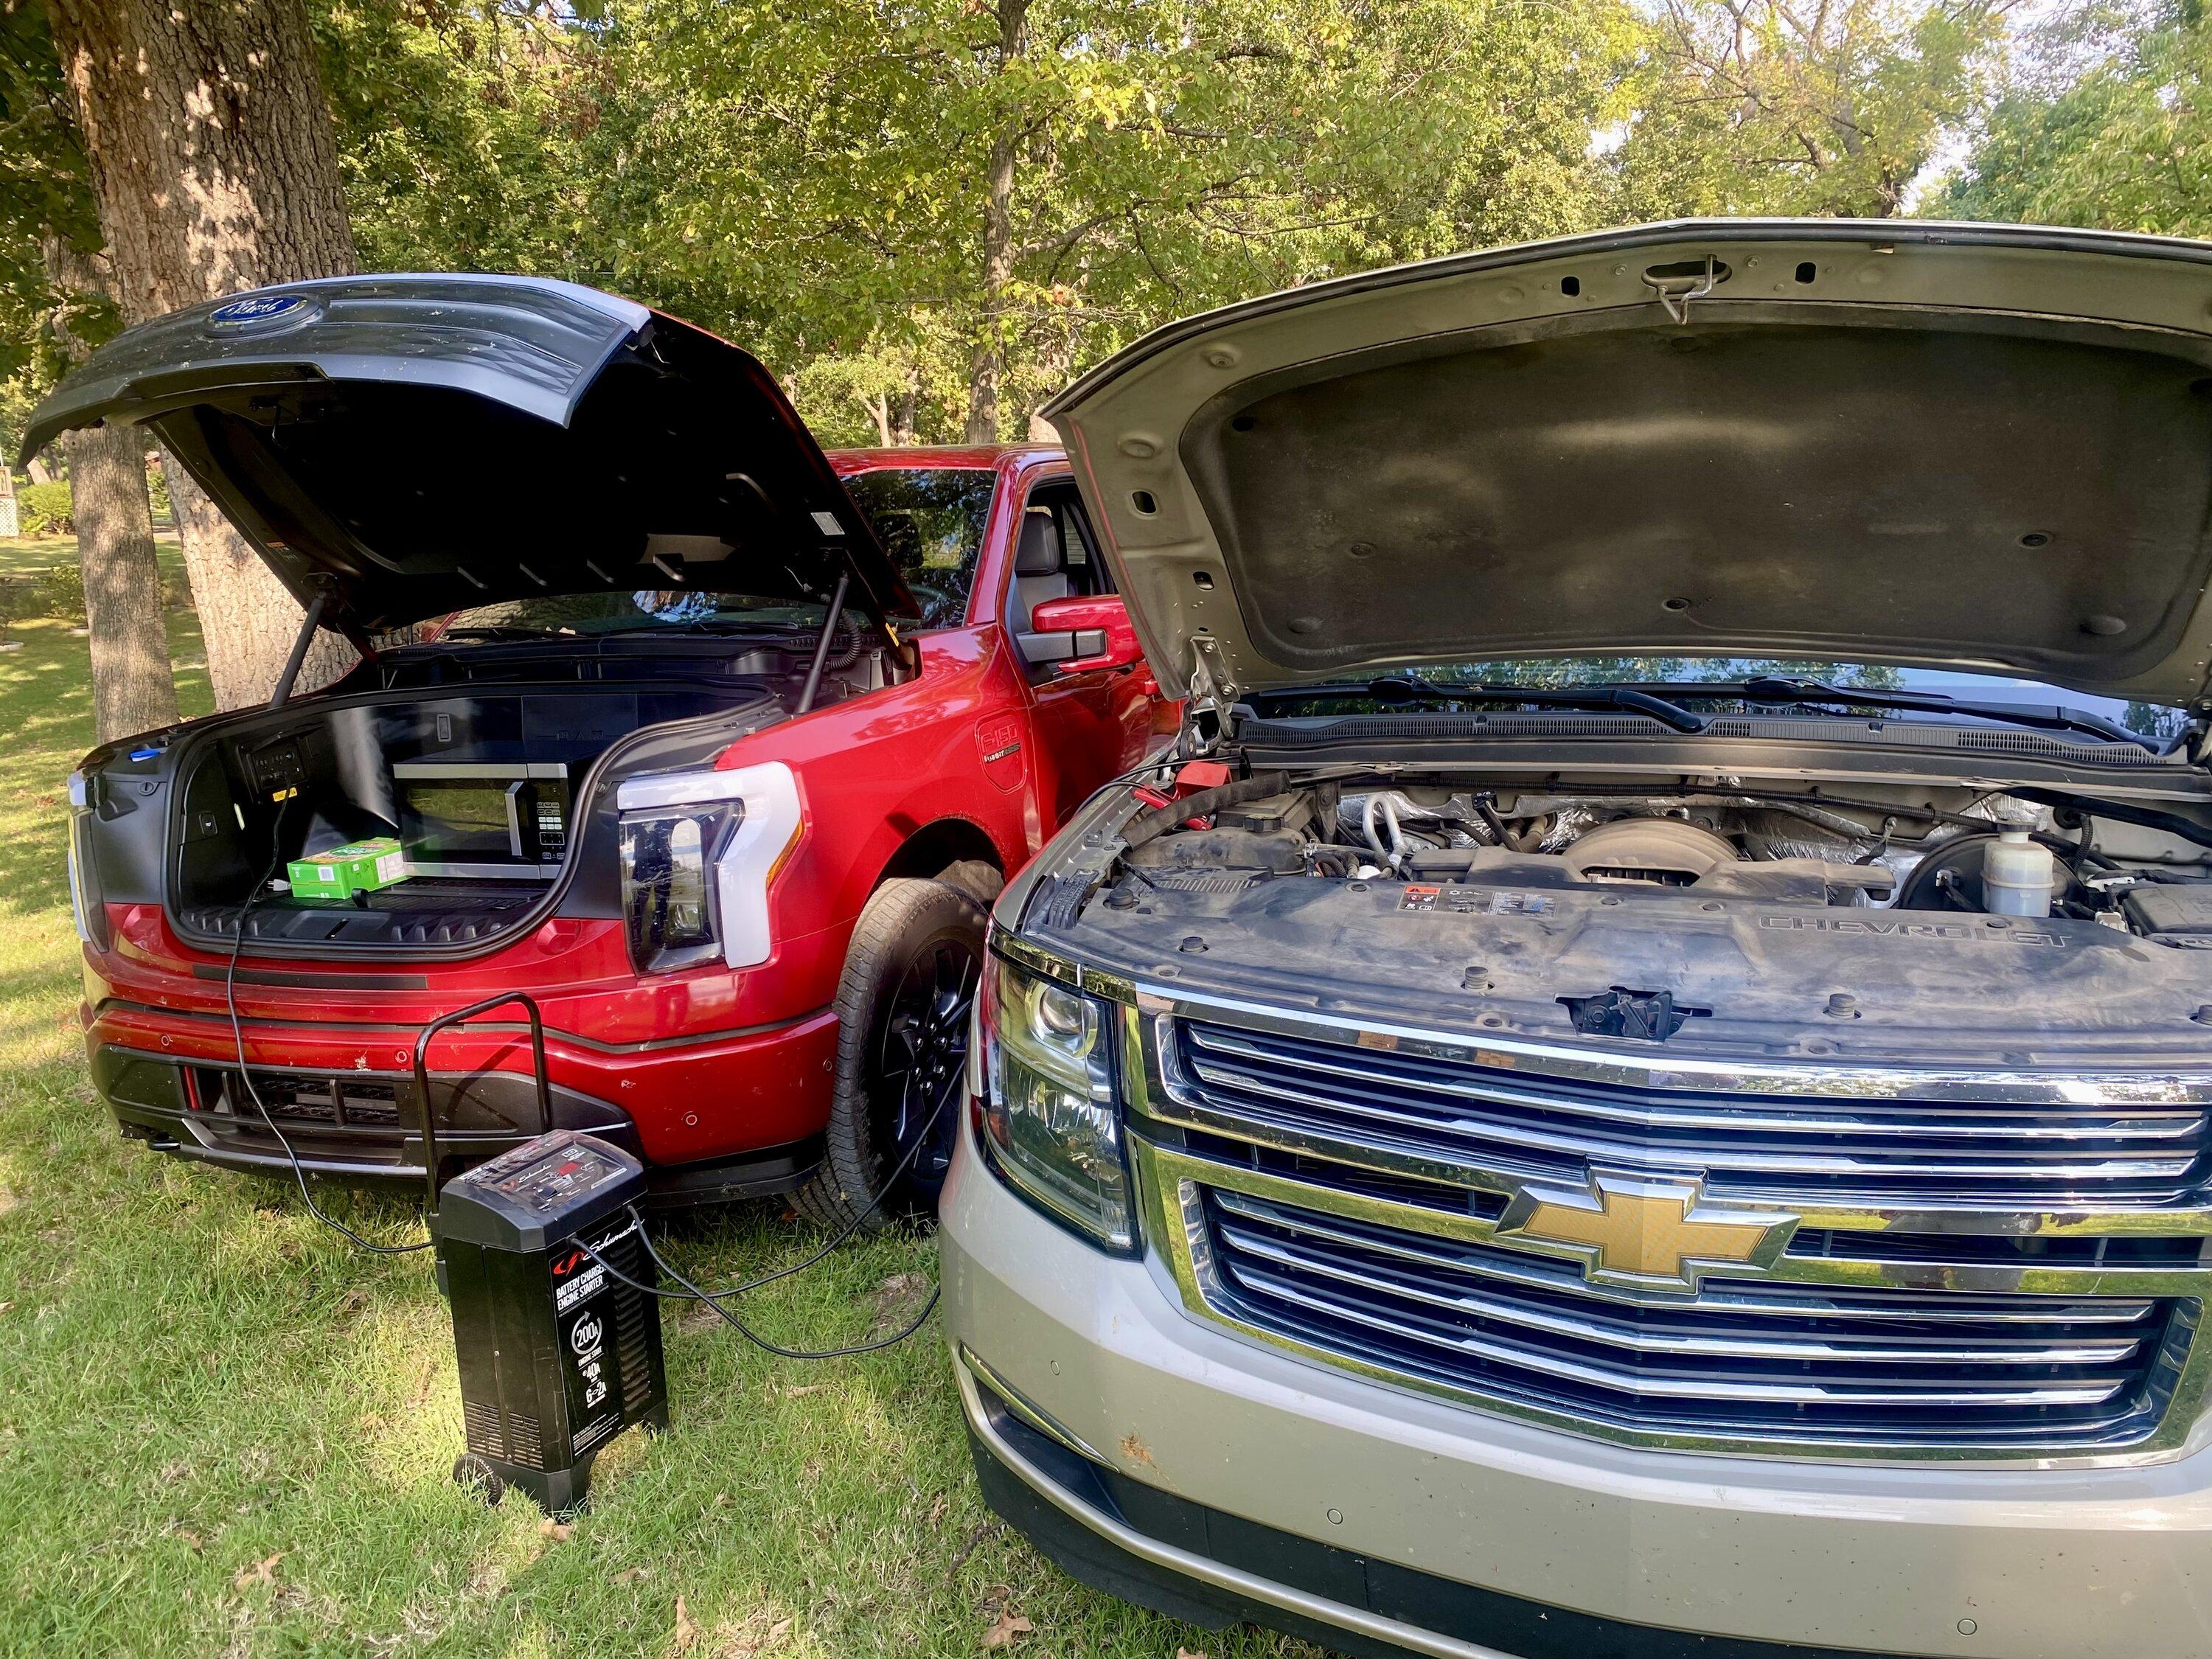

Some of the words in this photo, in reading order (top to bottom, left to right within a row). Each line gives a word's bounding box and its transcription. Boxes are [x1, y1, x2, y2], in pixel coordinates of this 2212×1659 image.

[225, 298, 284, 316] Ford
[981, 723, 1019, 753] F-150
[1760, 917, 2072, 947] CHEVROLET
[582, 1219, 645, 1262] Schumachr
[556, 1276, 580, 1300] BATTERY
[557, 1288, 580, 1312] ENGINE
[580, 1274, 604, 1298] STARTER
[576, 1321, 599, 1348] 200A
